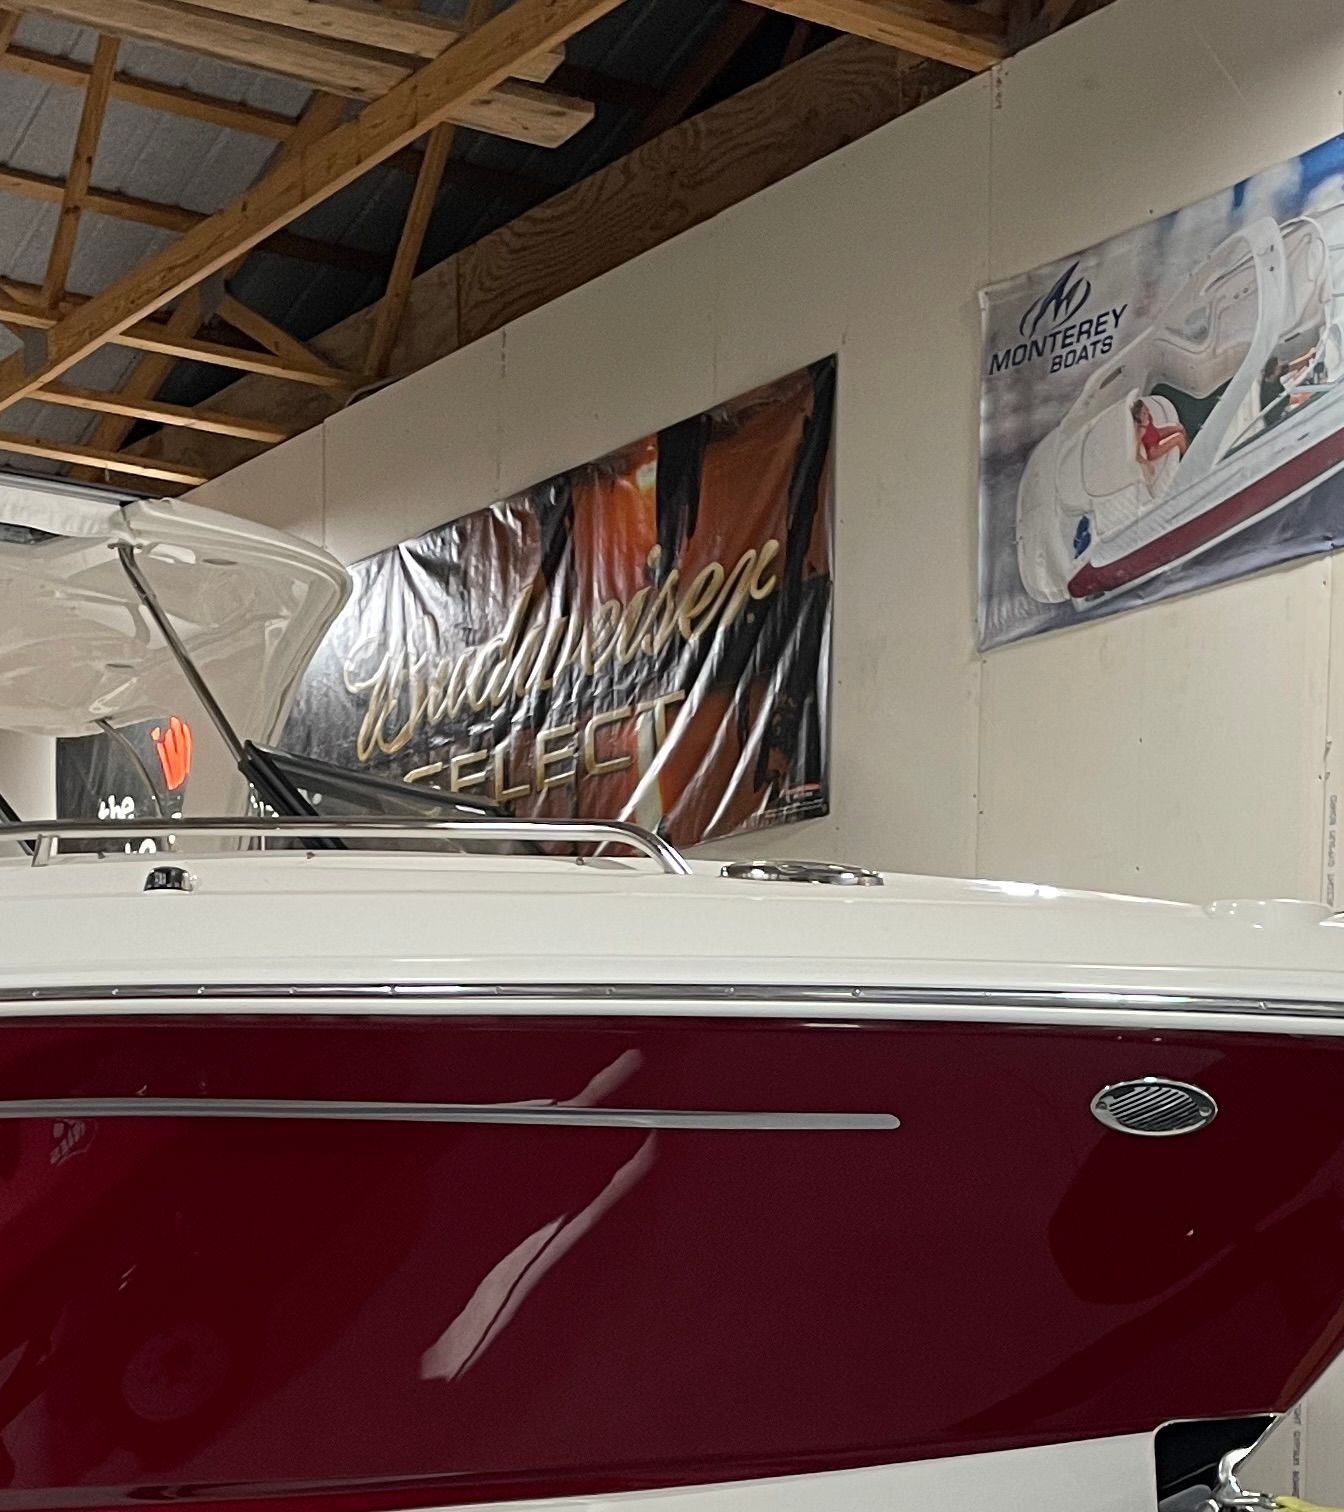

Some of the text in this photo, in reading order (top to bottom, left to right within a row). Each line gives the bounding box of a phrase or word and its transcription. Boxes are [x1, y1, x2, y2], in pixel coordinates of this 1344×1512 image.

[989, 303, 1128, 375] MONTEREY
[1049, 335, 1114, 374] BOATS
[344, 539, 780, 763] Budweiser
